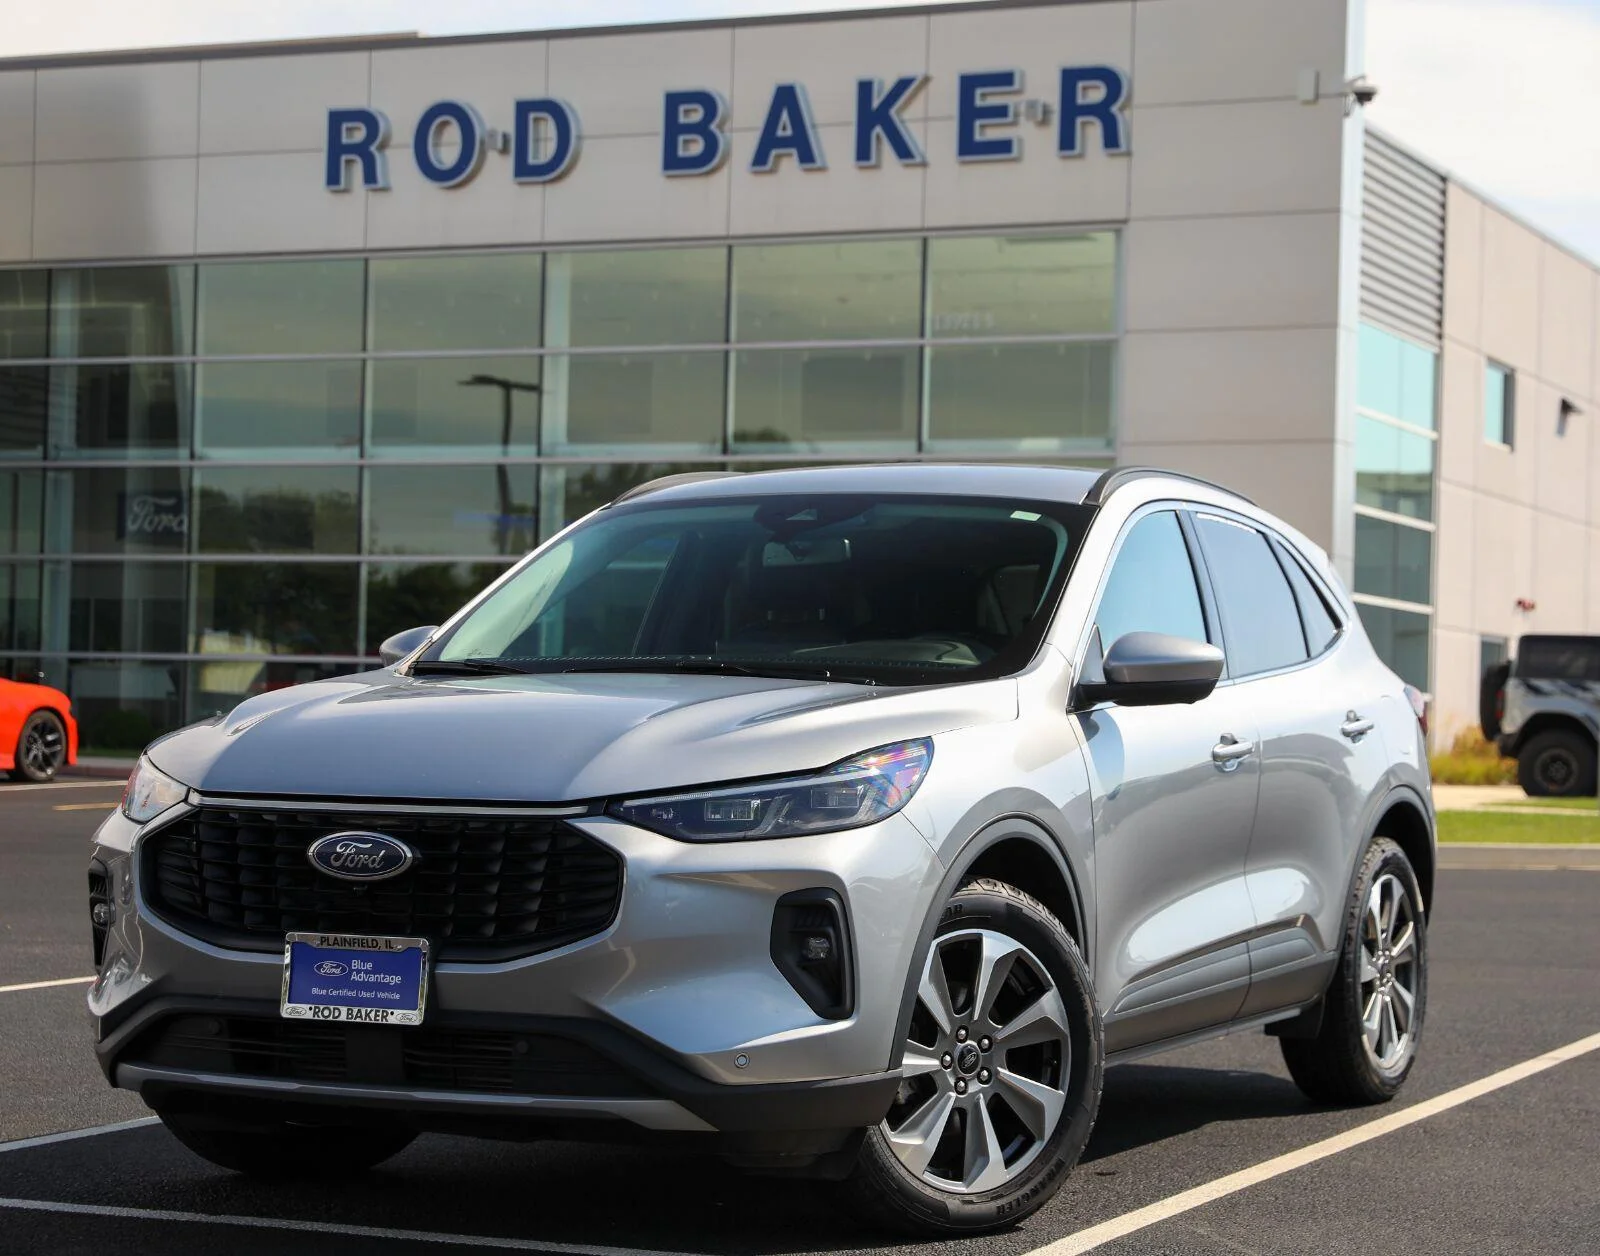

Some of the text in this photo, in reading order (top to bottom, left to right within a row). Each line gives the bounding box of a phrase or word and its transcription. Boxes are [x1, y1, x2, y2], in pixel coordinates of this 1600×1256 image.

[325, 65, 1131, 191] ROD BAKER
[330, 840, 386, 868] Ford
[320, 936, 394, 950] PLAINFIELD, IL
[320, 962, 342, 974] Ford
[351, 960, 373, 970] Blue
[351, 971, 402, 985] Advantage
[328, 988, 356, 997] Certified
[358, 990, 375, 998] Used
[377, 991, 400, 1000] Vehicle
[312, 1005, 389, 1022] ROD BAKER
